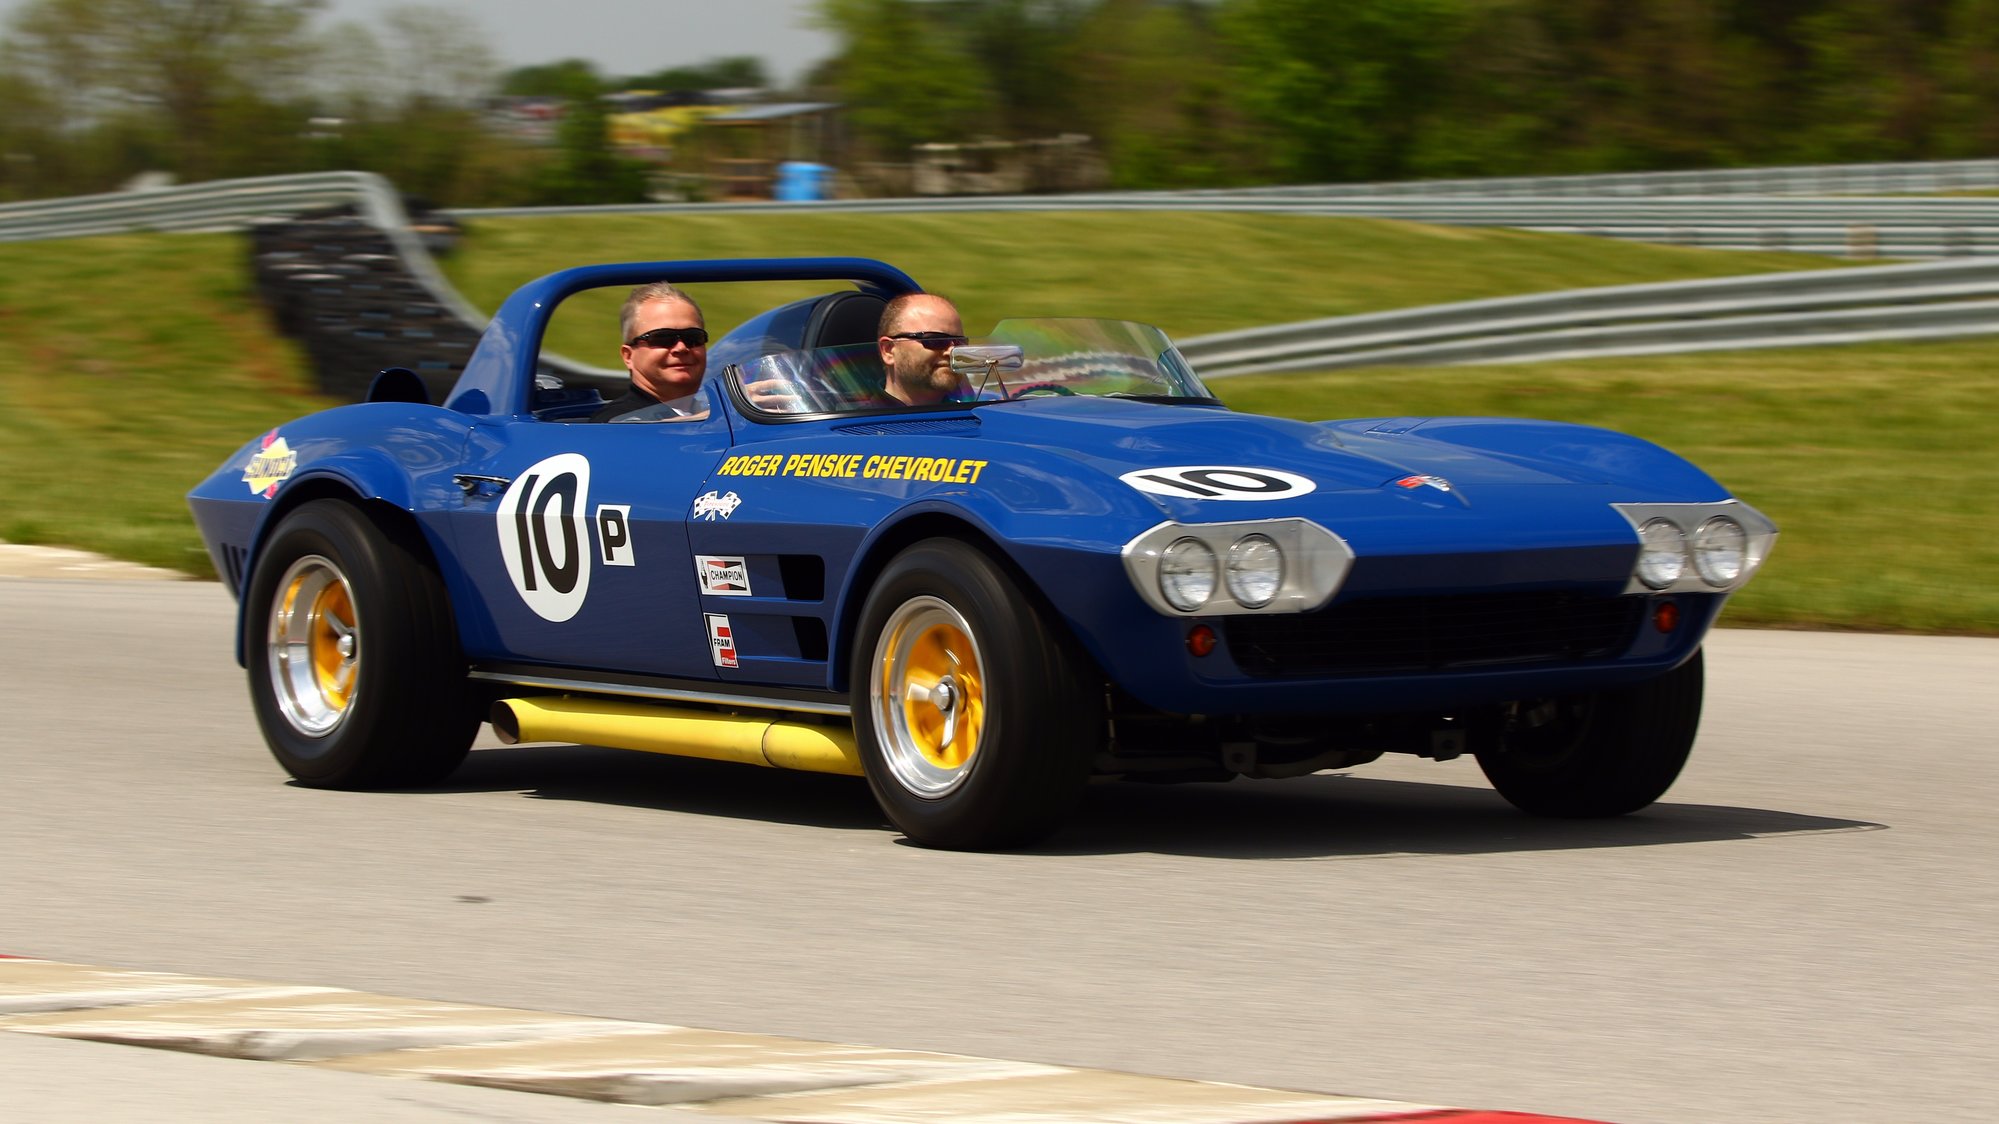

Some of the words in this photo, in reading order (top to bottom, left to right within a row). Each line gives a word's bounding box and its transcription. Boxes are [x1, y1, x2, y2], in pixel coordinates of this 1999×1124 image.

[717, 454, 784, 476] ROGER
[781, 454, 864, 478] PENSKE
[862, 455, 988, 484] CHEVROLET
[1134, 469, 1293, 497] 10
[515, 471, 579, 594] 10
[599, 509, 627, 561] P
[710, 570, 743, 581] CHAMPION
[713, 638, 731, 647] FRAM
